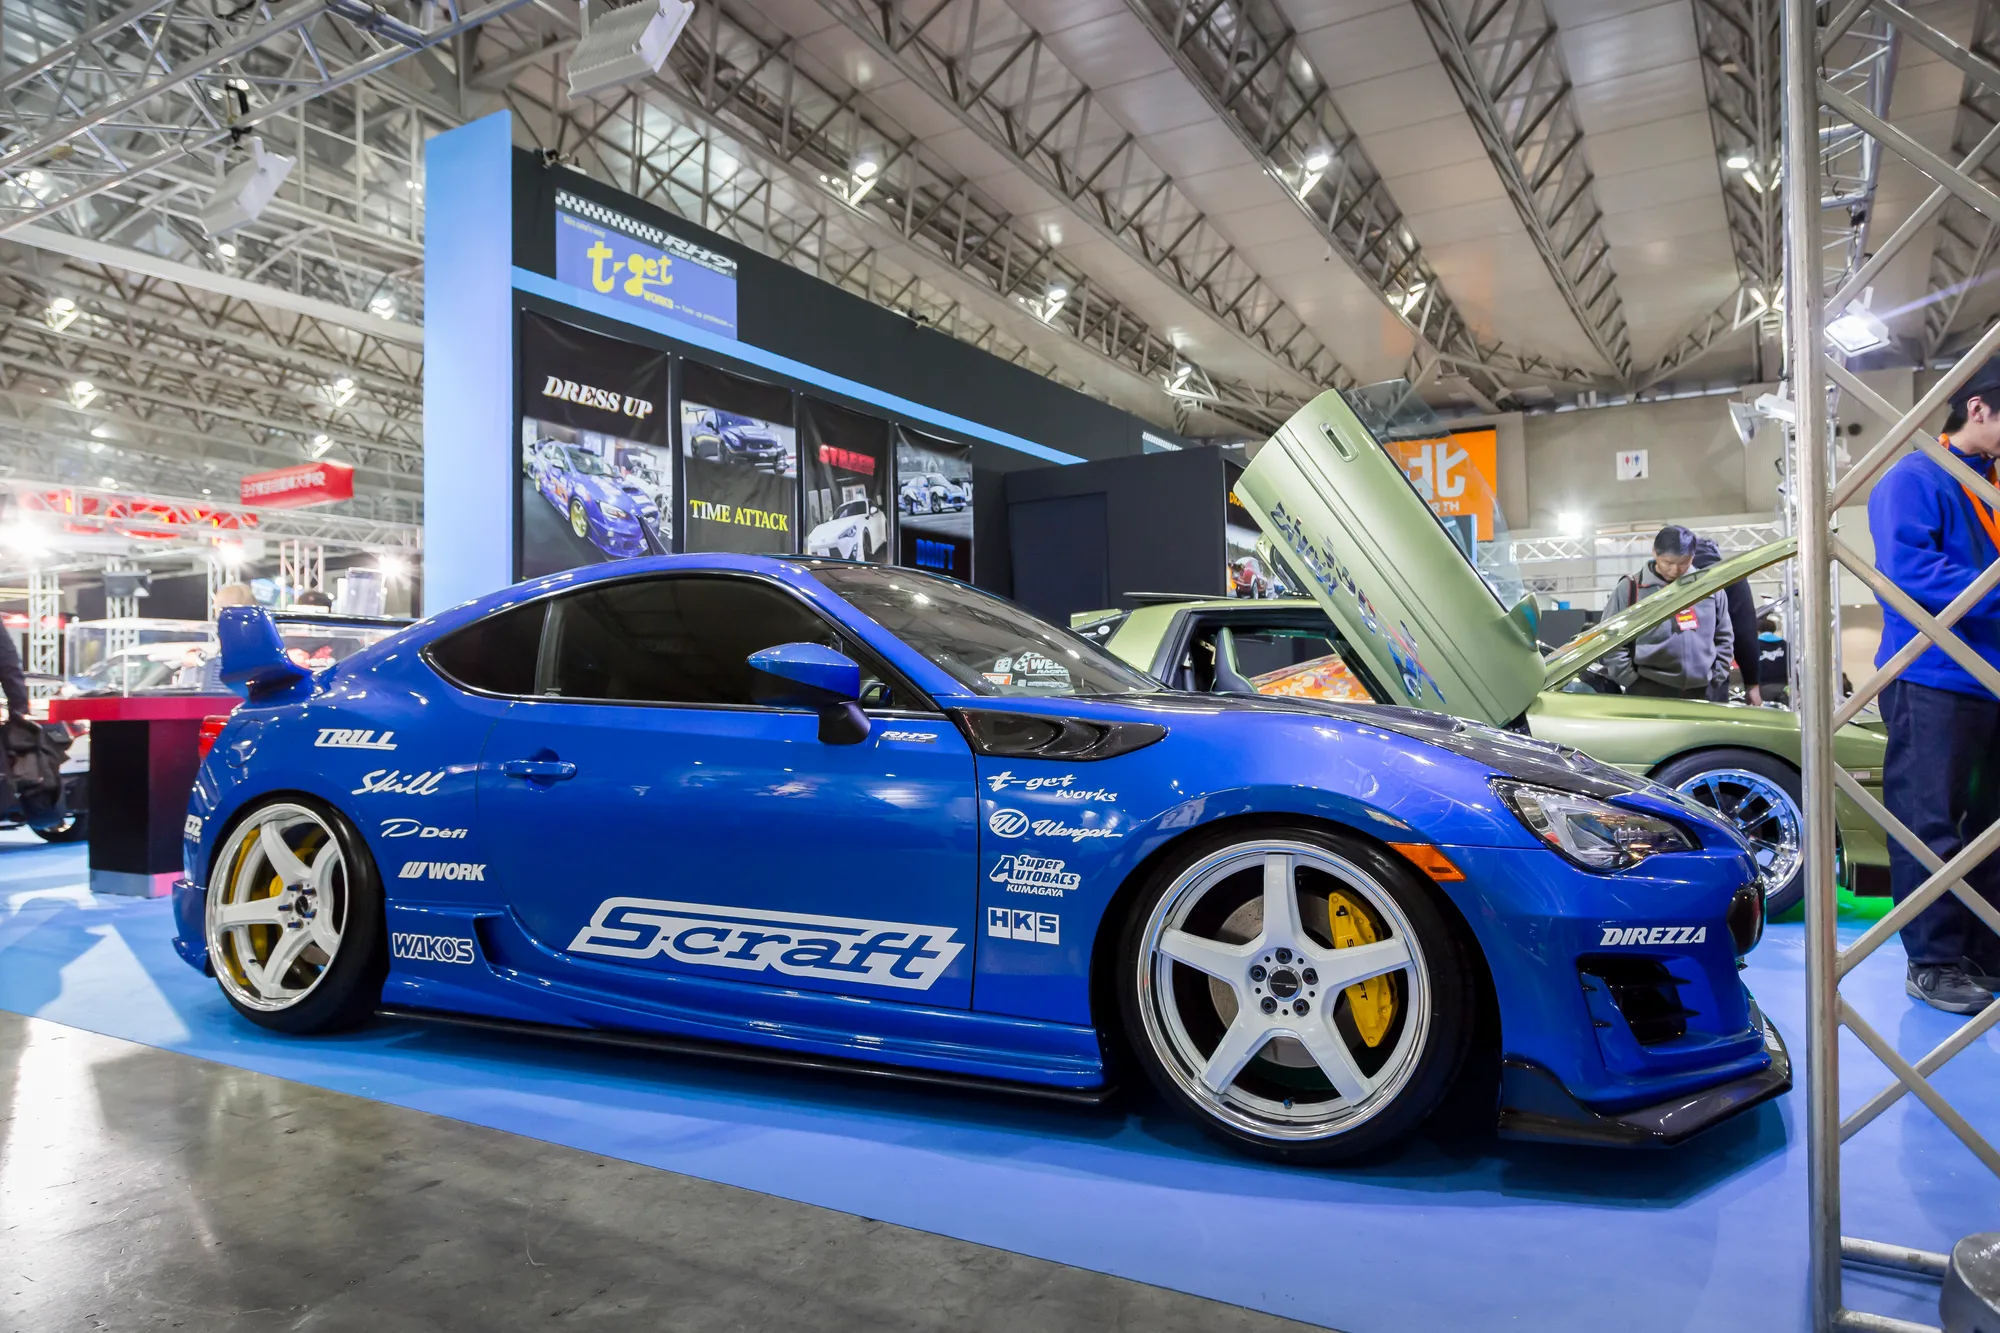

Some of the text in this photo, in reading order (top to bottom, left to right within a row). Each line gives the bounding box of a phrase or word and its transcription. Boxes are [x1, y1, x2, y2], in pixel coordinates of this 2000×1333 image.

[542, 375, 654, 420] DRESS UP
[1408, 443, 1469, 500] 北
[689, 499, 789, 532] TIME ATTACK
[314, 728, 398, 750] TRILL
[351, 769, 446, 795] Skill
[1054, 788, 1118, 802] works
[1031, 819, 1123, 843] Wangan
[428, 862, 487, 882] WORK
[990, 856, 1080, 888] AUTOBACS
[1017, 855, 1064, 870] Super
[1006, 883, 1064, 898] KUMAGAYA
[987, 906, 1060, 945] HKS
[1600, 926, 1707, 946] DIREZZA
